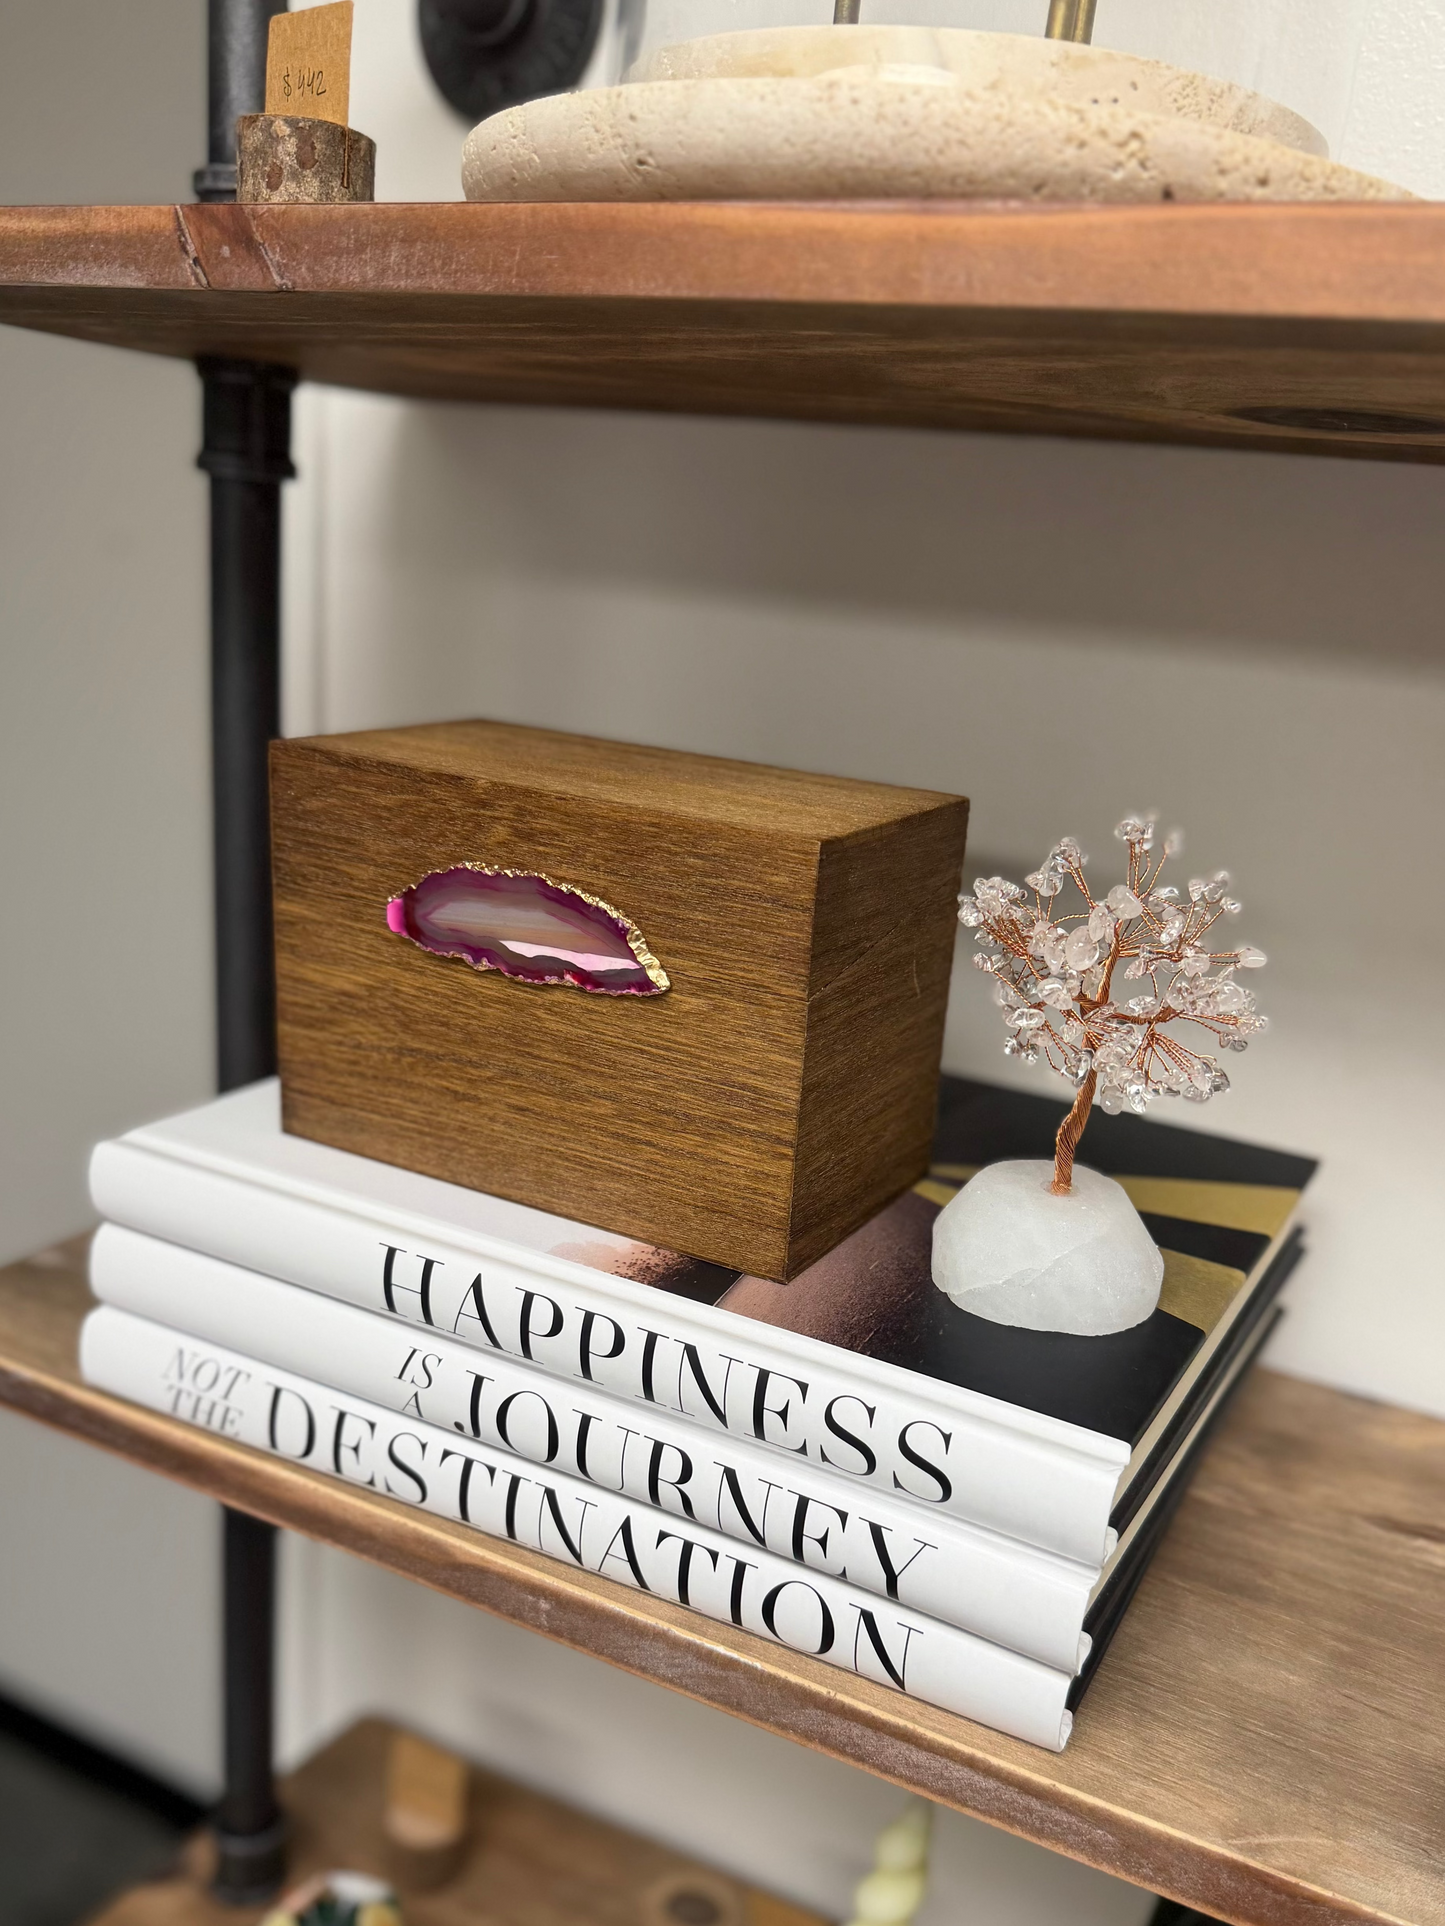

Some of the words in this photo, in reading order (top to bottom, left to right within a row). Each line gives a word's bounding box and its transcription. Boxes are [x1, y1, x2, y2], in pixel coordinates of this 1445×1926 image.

[162, 1347, 251, 1403] NOT
[379, 1242, 953, 1503] HAPPINESS
[393, 1346, 443, 1390] IS
[164, 1384, 245, 1440] THE
[401, 1390, 427, 1418] A
[453, 1370, 938, 1601] JOURNEY
[264, 1381, 924, 1692] DESTINATION
